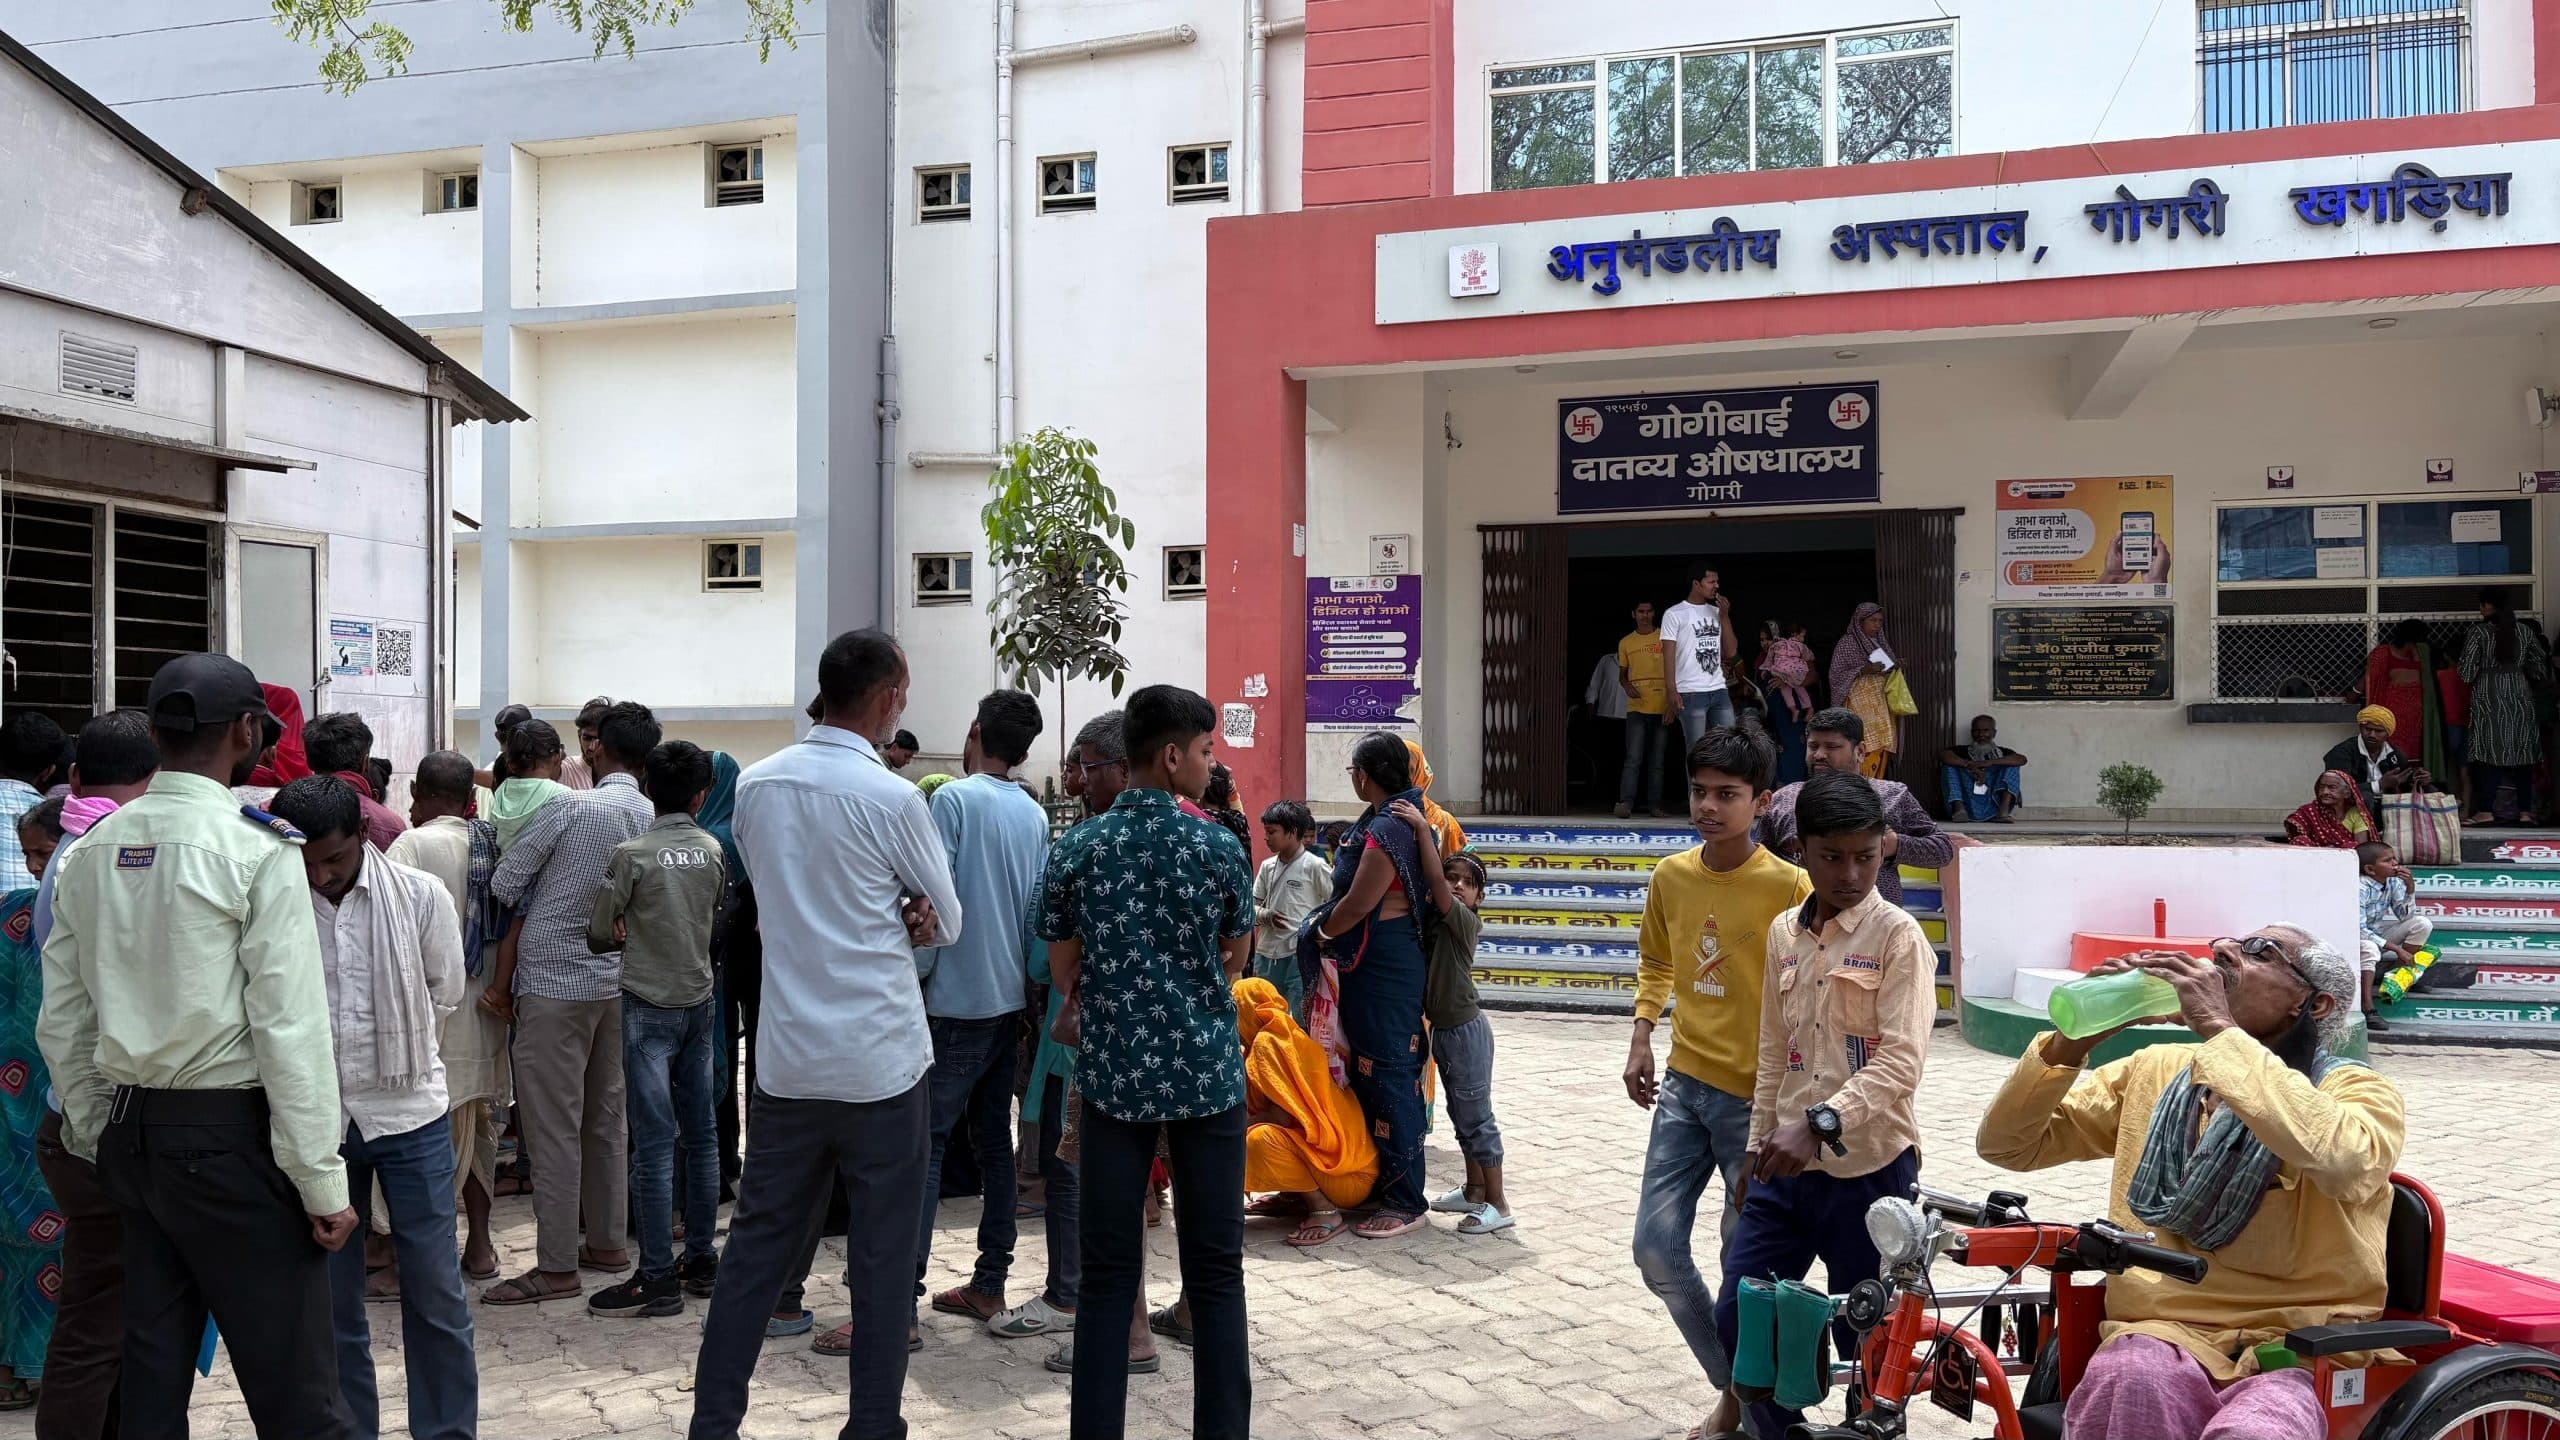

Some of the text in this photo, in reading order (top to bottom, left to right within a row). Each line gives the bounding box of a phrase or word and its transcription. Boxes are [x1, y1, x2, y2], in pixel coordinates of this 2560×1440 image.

[1547, 162, 2512, 296] अनुमंडलीय अस्पताल, गोगरी खगड़िया
[1638, 396, 1793, 439] गोगीबाई
[1571, 441, 1864, 482] दातव्य औषधालय
[1686, 480, 1743, 501] गोगरी
[2015, 515, 2036, 526] आभा
[2007, 526, 2077, 540] डिजिटल हो जाओ
[1313, 596, 1342, 605] आभा
[1312, 605, 1410, 617] डिजिटल हो जाओ
[2063, 642, 2110, 654] संजीव
[2114, 644, 2161, 657] कुमार
[662, 850, 707, 866] ARM
[1517, 856, 1572, 869] बीच
[2413, 874, 2483, 888] यमित
[2453, 906, 2555, 918] अपनाना
[1480, 915, 1560, 926] ताल
[1549, 943, 1595, 957] ही
[1843, 958, 1880, 971] BRONX
[1693, 981, 1725, 998] PUMA
[2415, 1006, 2559, 1022] स्वच्छता में
